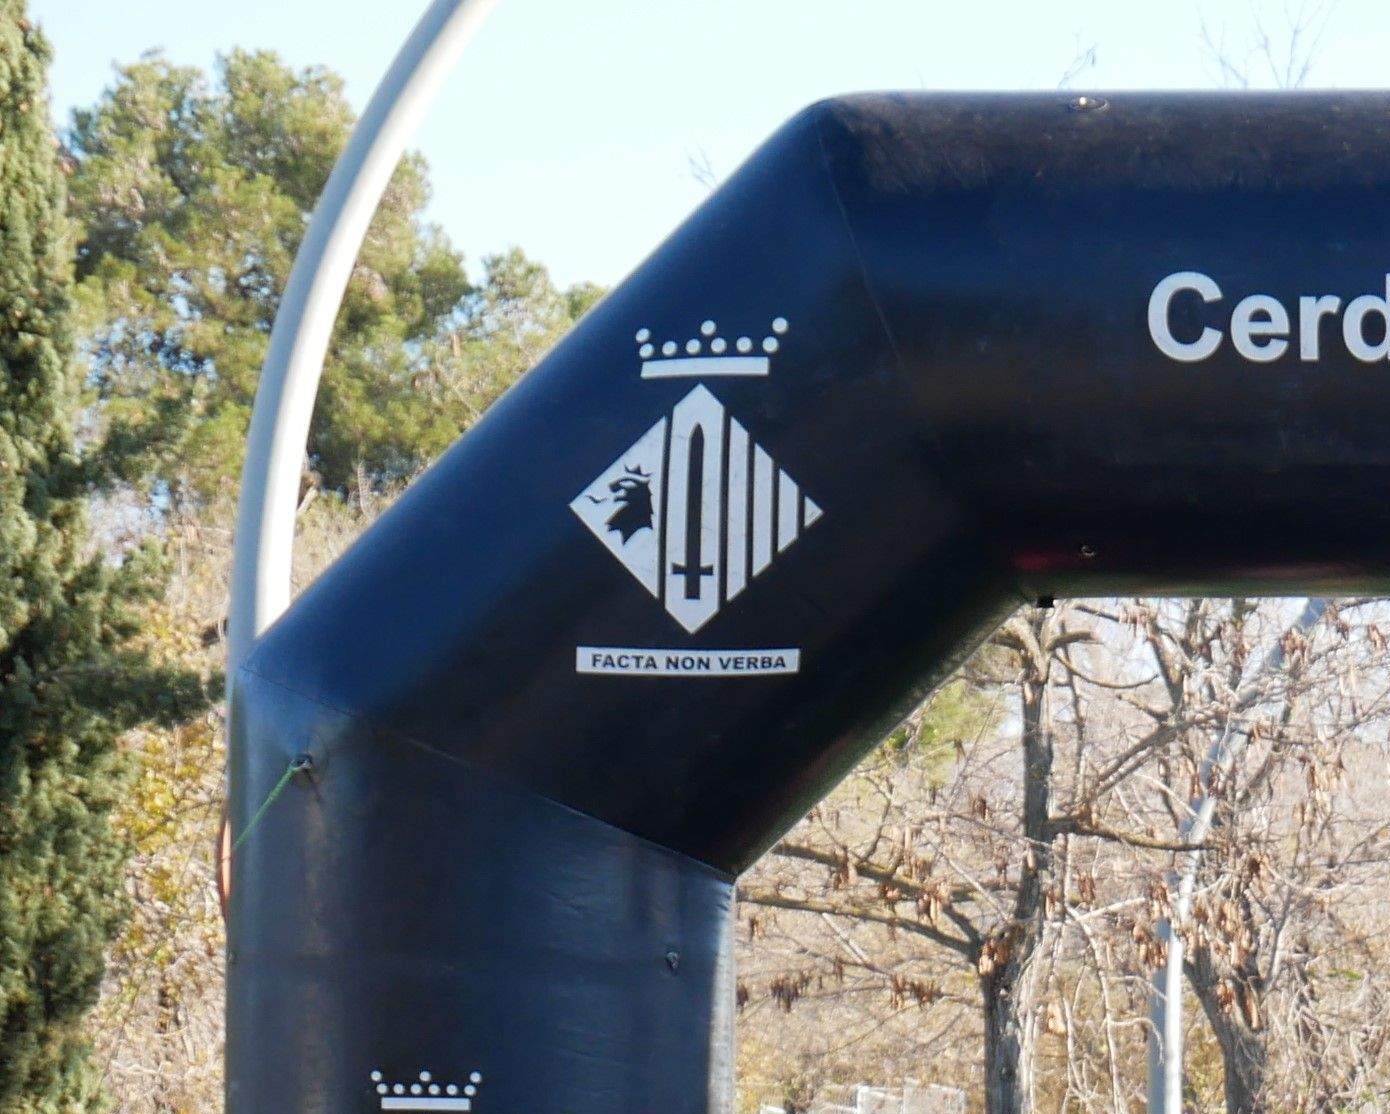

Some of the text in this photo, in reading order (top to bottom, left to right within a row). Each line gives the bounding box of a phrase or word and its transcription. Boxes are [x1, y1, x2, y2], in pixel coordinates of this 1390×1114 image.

[591, 653, 787, 671] FACTA NON VERBA
